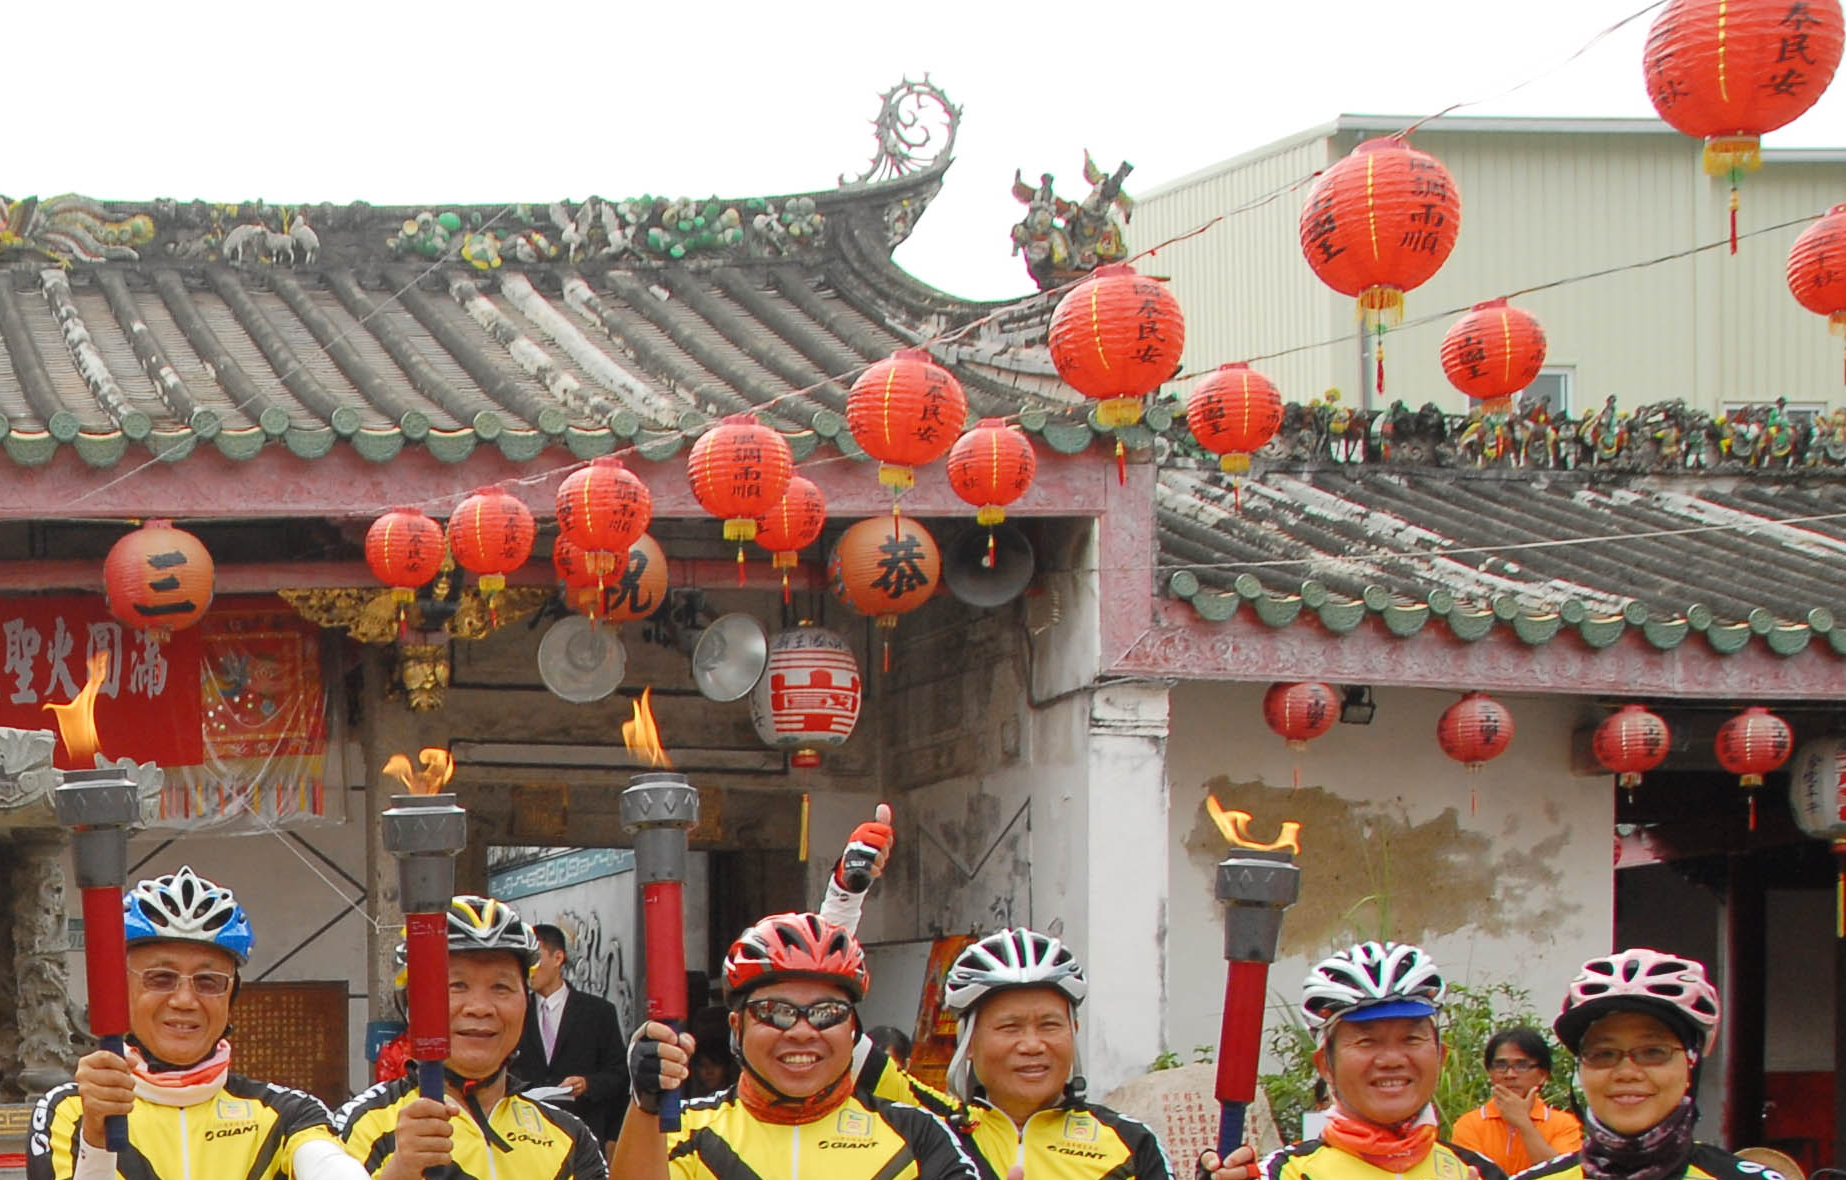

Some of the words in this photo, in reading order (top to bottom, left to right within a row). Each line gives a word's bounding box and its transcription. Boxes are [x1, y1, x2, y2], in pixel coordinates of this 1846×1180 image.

[1399, 158, 1447, 256] 風調雨順
[1130, 283, 1168, 365] 國泰民安
[911, 368, 949, 444] 國泰民安
[732, 432, 763, 499] 風調雨順
[133, 550, 197, 617] 三
[871, 534, 930, 599] 恭
[216, 1122, 260, 1140] GIANT
[830, 1139, 879, 1150] GIANT
[1058, 1147, 1107, 1160] GIANT
